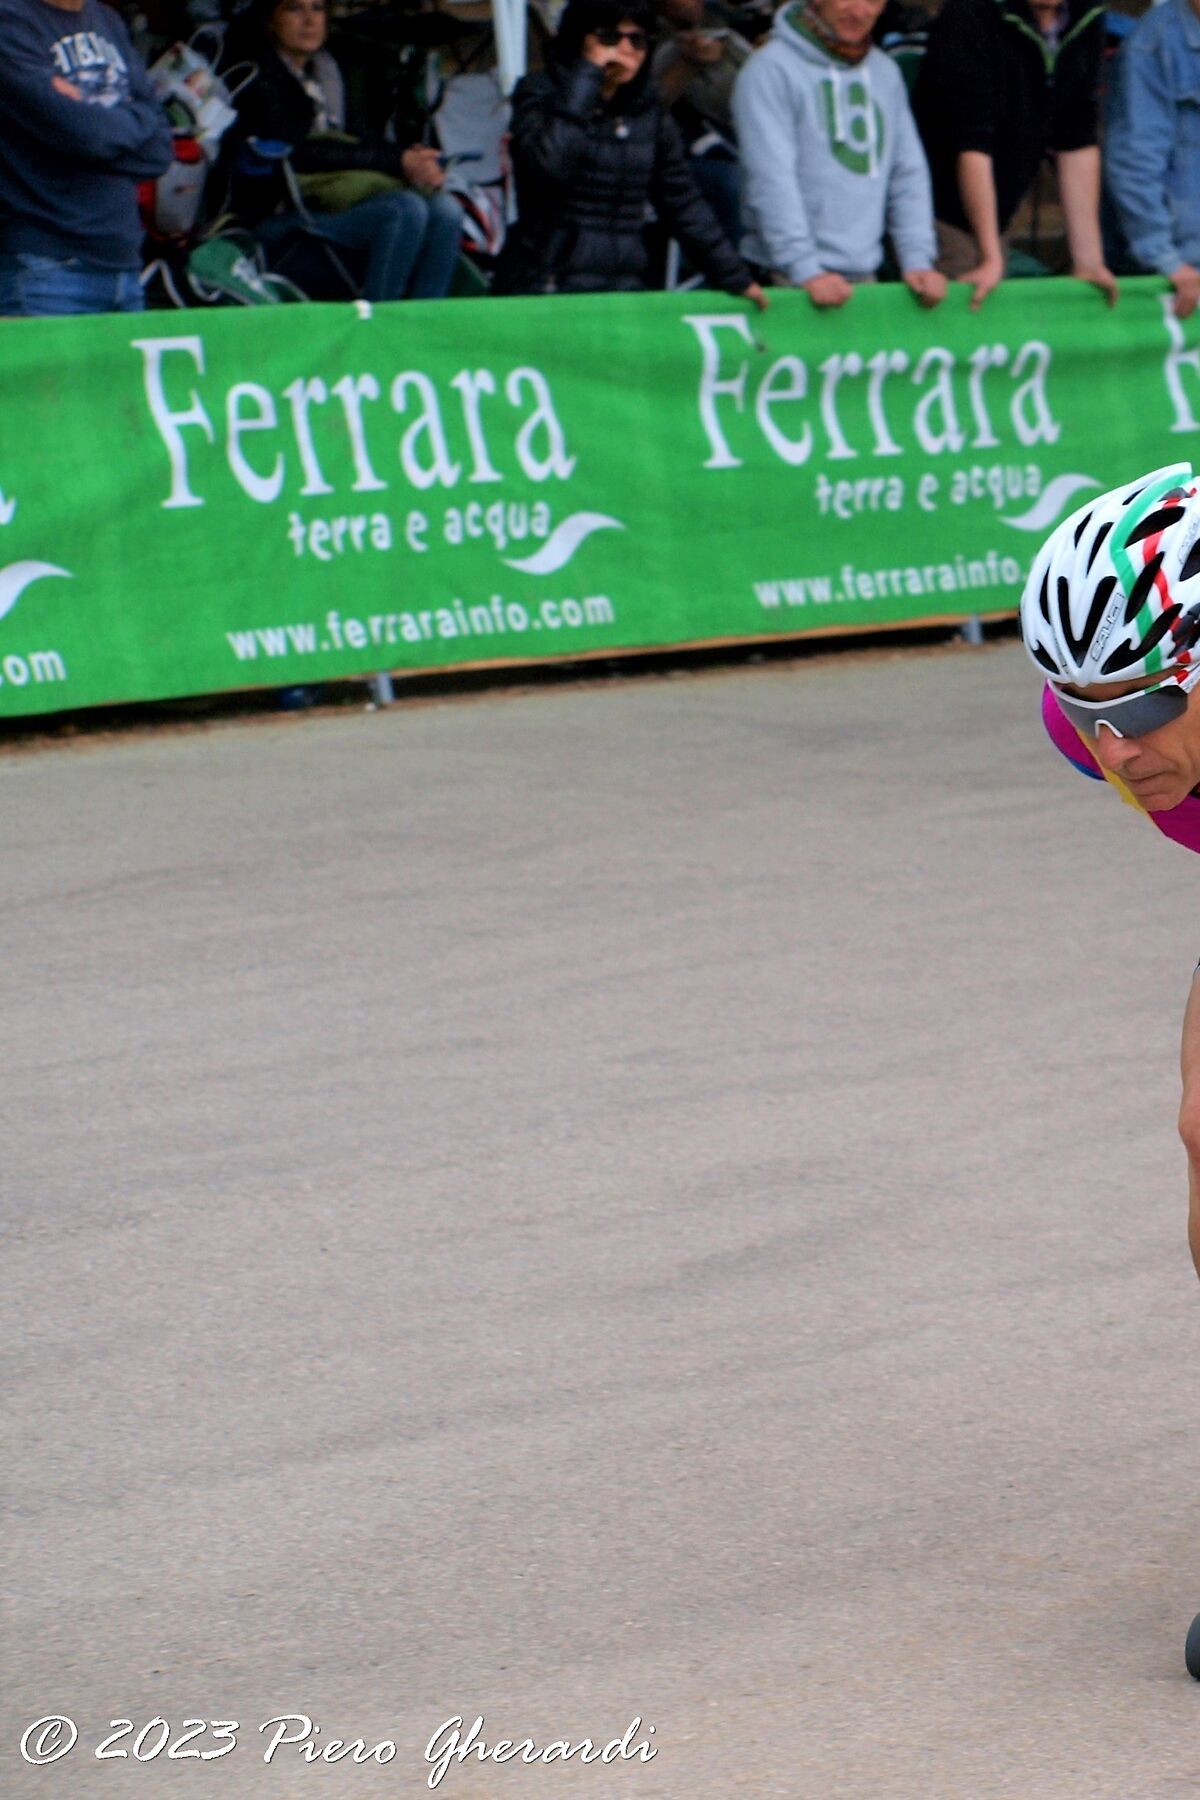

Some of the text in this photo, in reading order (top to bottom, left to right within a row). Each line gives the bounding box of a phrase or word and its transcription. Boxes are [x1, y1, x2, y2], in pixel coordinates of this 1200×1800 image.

[130, 335, 577, 508] Ferrara
[680, 313, 1061, 468] Ferrara
[815, 464, 1042, 518] terra e acqua
[288, 500, 551, 561] terra e acqua
[227, 595, 614, 660] www.ferrarainfo.com
